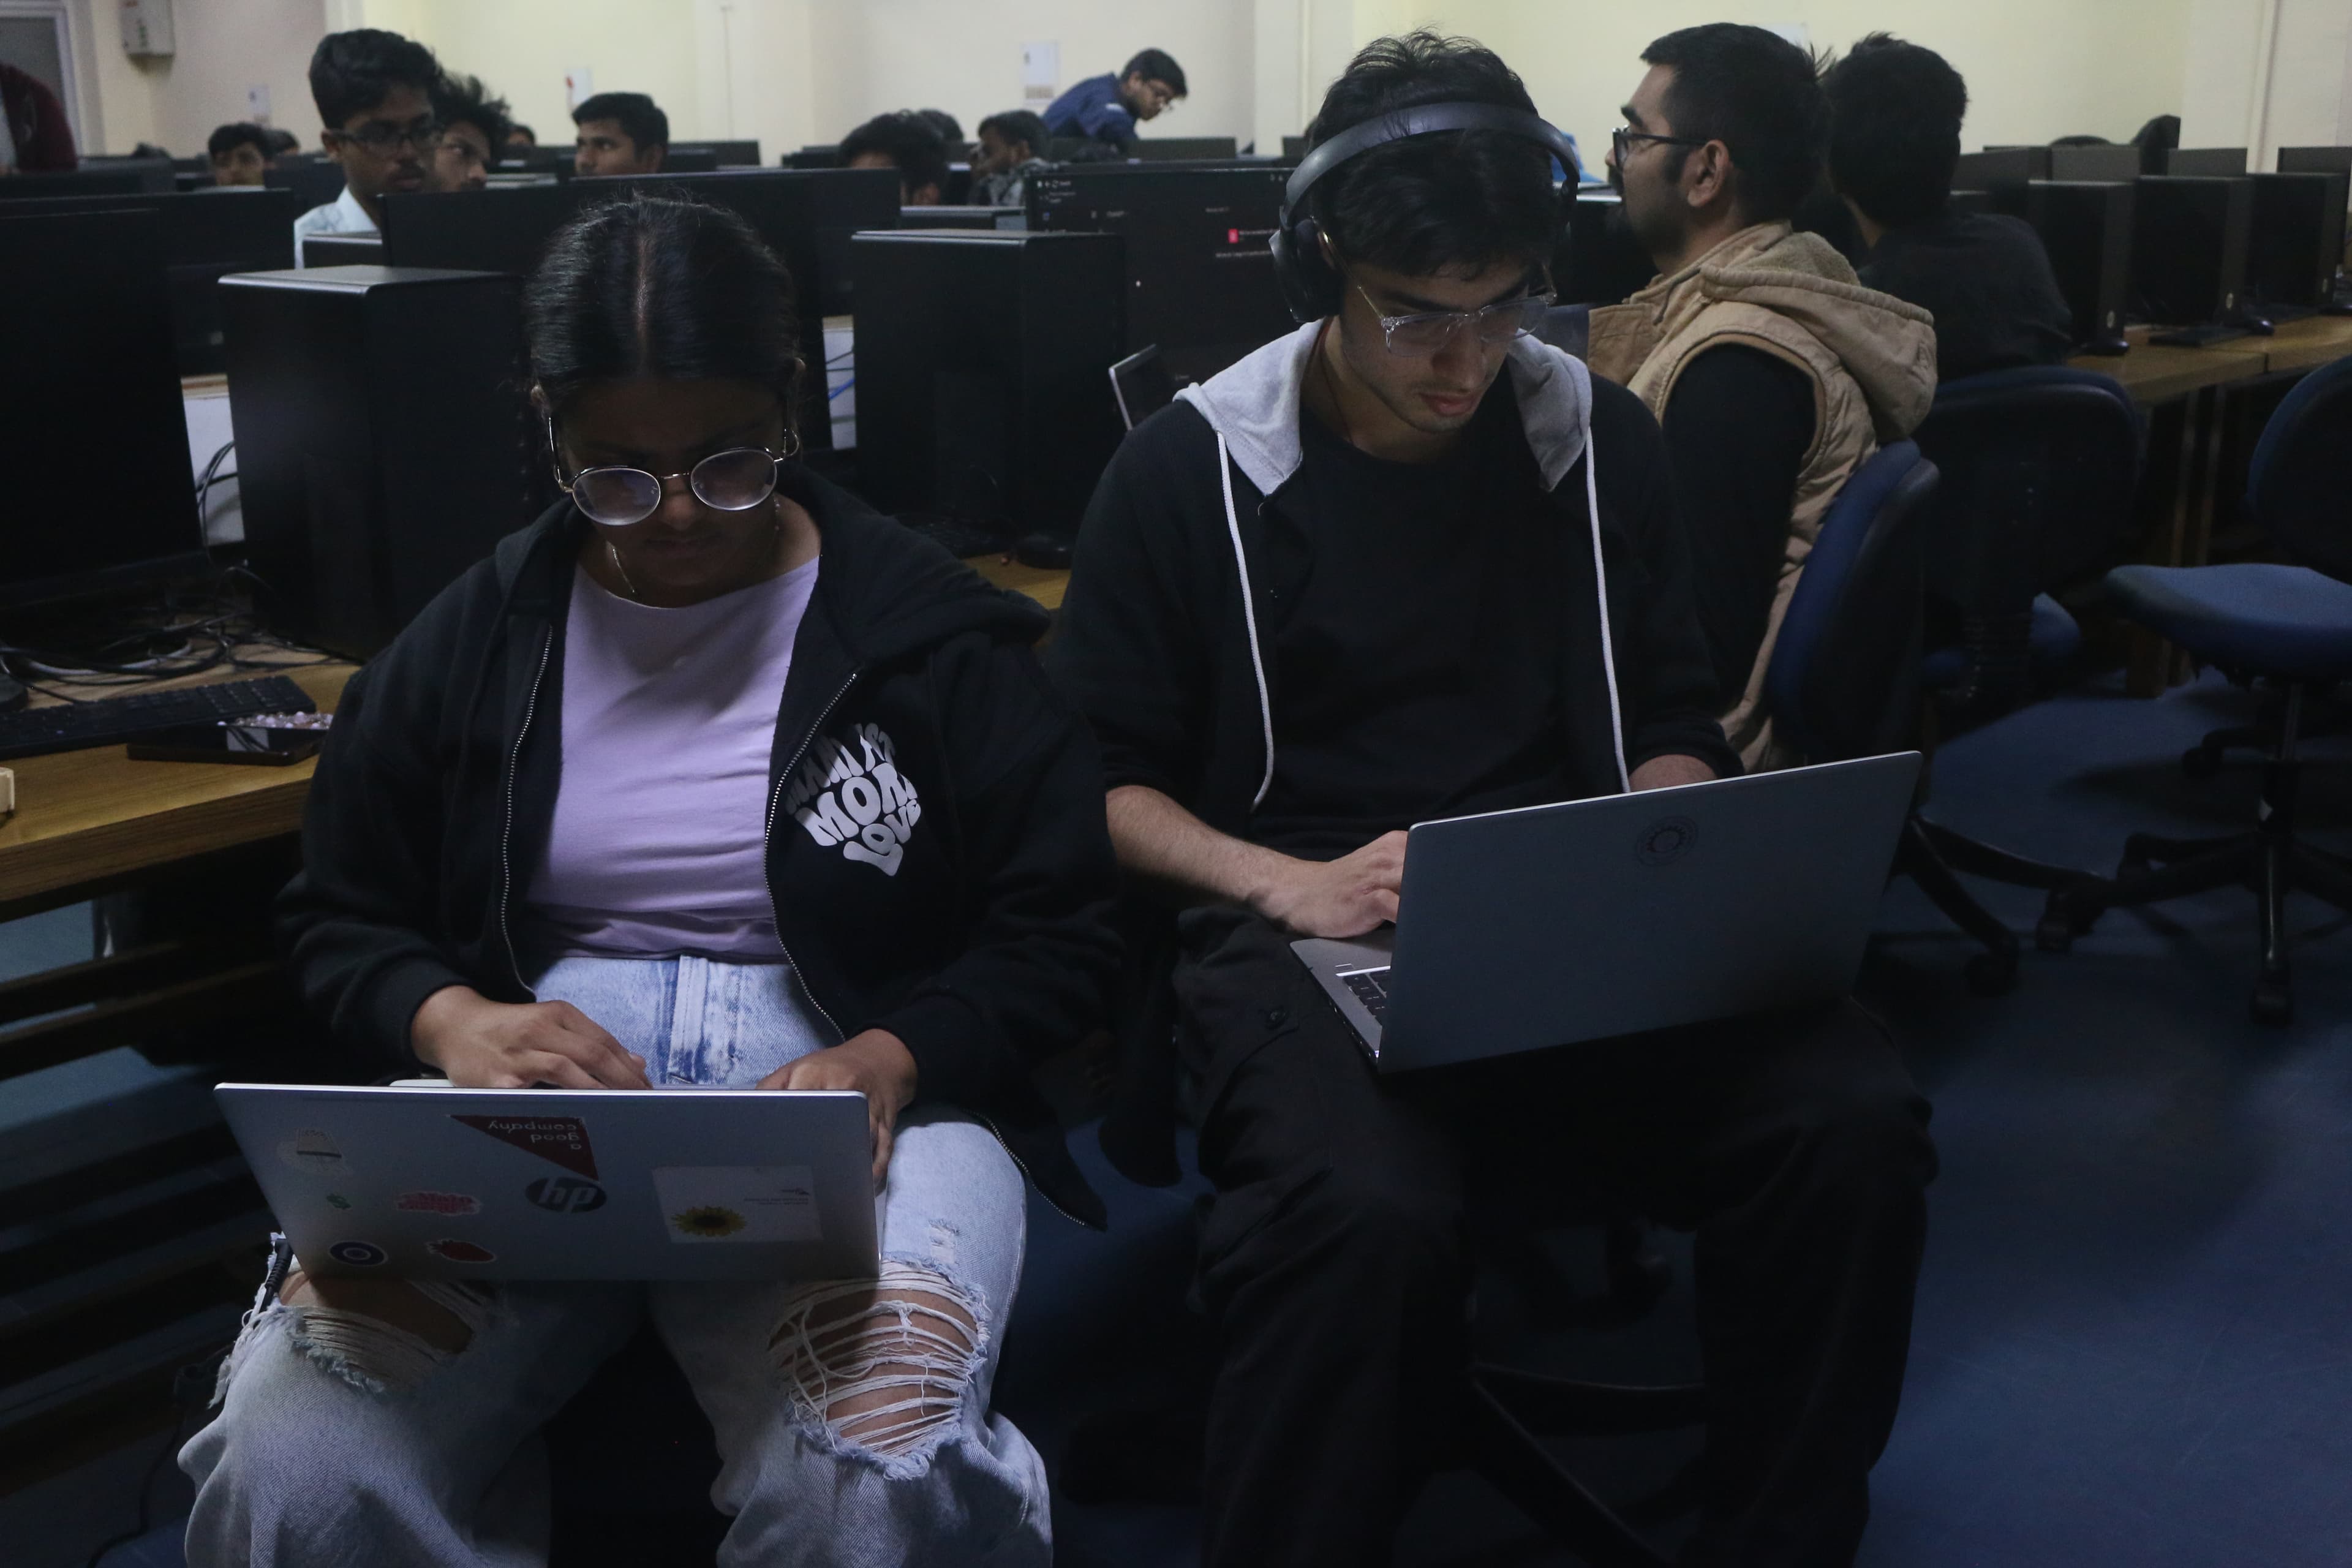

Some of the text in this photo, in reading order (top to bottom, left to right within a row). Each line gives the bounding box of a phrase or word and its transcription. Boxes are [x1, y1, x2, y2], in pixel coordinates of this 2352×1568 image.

[843, 799, 922, 877] LOVE
[488, 1120, 578, 1134] company
[530, 1132, 579, 1143] good
[536, 1177, 598, 1213] hp
